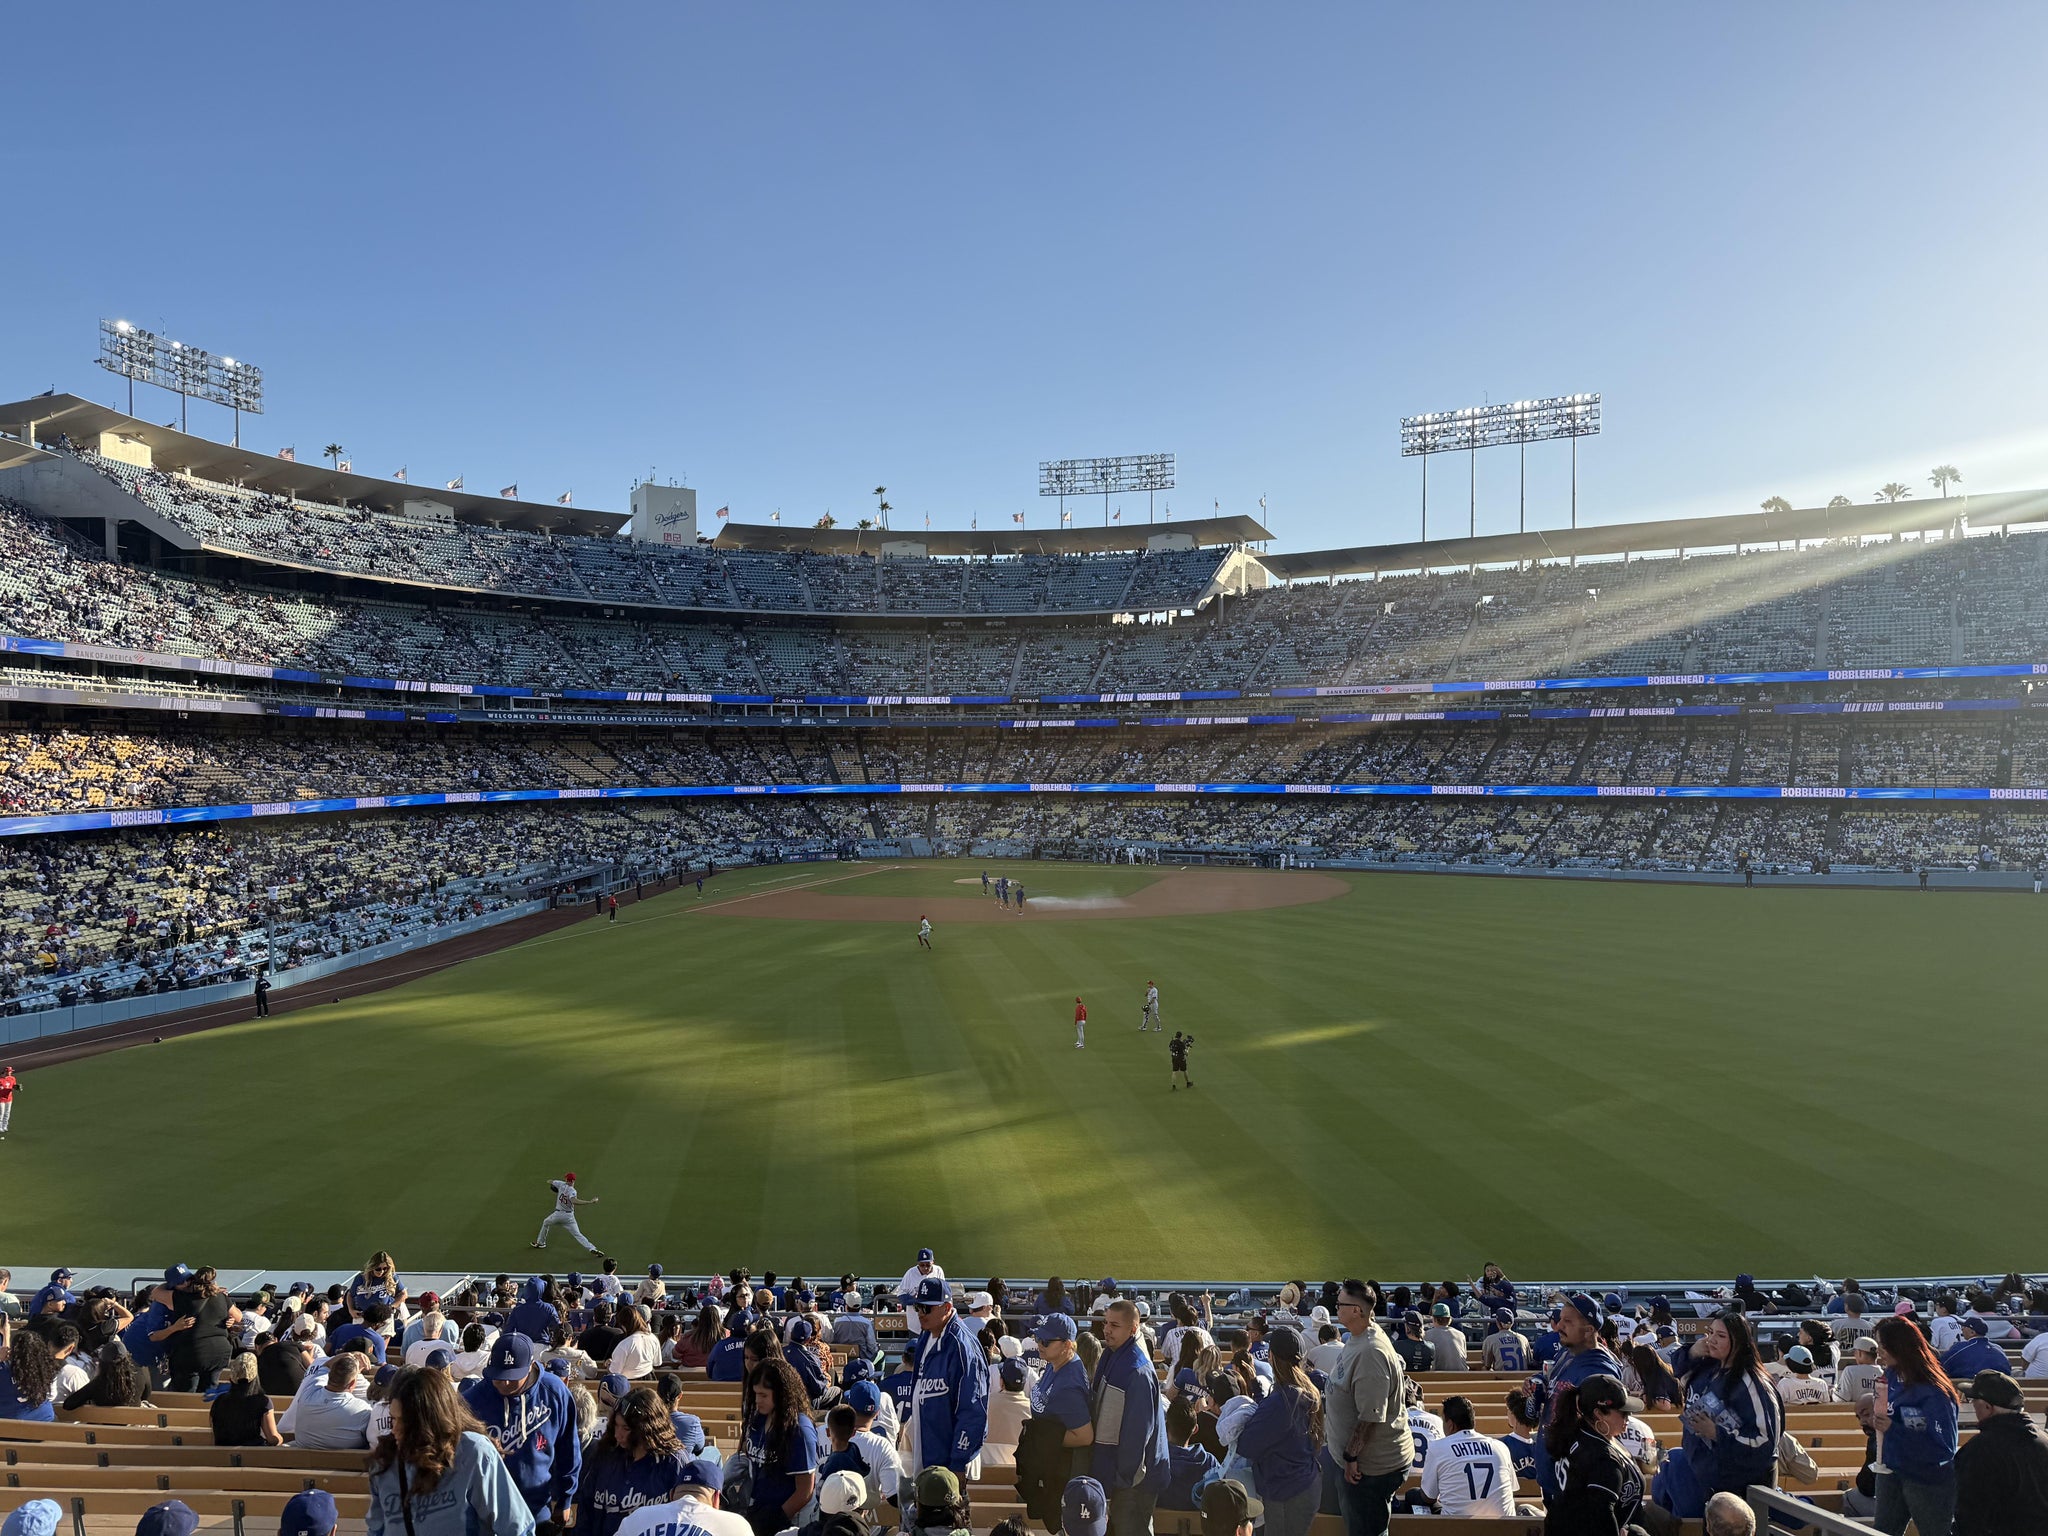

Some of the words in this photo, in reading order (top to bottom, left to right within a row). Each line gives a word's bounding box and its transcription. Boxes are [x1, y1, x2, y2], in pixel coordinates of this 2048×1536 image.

[654, 511, 690, 527] Dodgers
[75, 650, 94, 658] BANK
[105, 653, 133, 662] AMERICA
[234, 663, 273, 678] BOBBLEHEAD
[1828, 670, 1892, 680] BOBBLEHEAD
[1484, 680, 1536, 690] BOBBLEHEAD
[1648, 675, 1705, 685] BOBBLEHEAD
[429, 682, 473, 694] BOBBLEHEAD
[665, 693, 712, 702] BOBBLEHEAD
[905, 696, 951, 704] BOBBLEHEAD
[1137, 692, 1181, 702] BOBBLEHEAD
[1888, 701, 1944, 711] BOBBLEHEAD
[1629, 707, 1675, 716] BOBBLEHEAD
[901, 784, 944, 792] BOBBLEHEAD
[1029, 783, 1072, 792] BOBBLEHEAD
[1154, 783, 1197, 792] BOBBLEHEAD
[1285, 784, 1331, 793] BOBBLEHEAD
[1431, 785, 1484, 795] BOBBLEHEAD
[1597, 786, 1656, 796] BOBBLEHEAD
[445, 792, 481, 804] BOBBLEHEAD
[558, 788, 600, 798] BOBBLEHEAD
[1780, 788, 1846, 798] BOBBLEHEAD
[252, 802, 290, 816] BOBBLEHEAD
[110, 810, 163, 827] BOBBLEHEAD
[885, 1319, 904, 1328] 306
[1678, 1323, 1697, 1332] 308
[724, 1342, 735, 1352] LOS
[503, 1350, 515, 1365] LA
[838, 1357, 845, 1365] B
[1500, 1347, 1525, 1371] 51
[1796, 1388, 1822, 1400] OHTANI
[727, 1425, 738, 1437] H
[957, 1430, 970, 1450] LA
[1451, 1441, 1493, 1457] OHTANI
[1463, 1462, 1495, 1500] 17
[1080, 1503, 1091, 1519] LA
